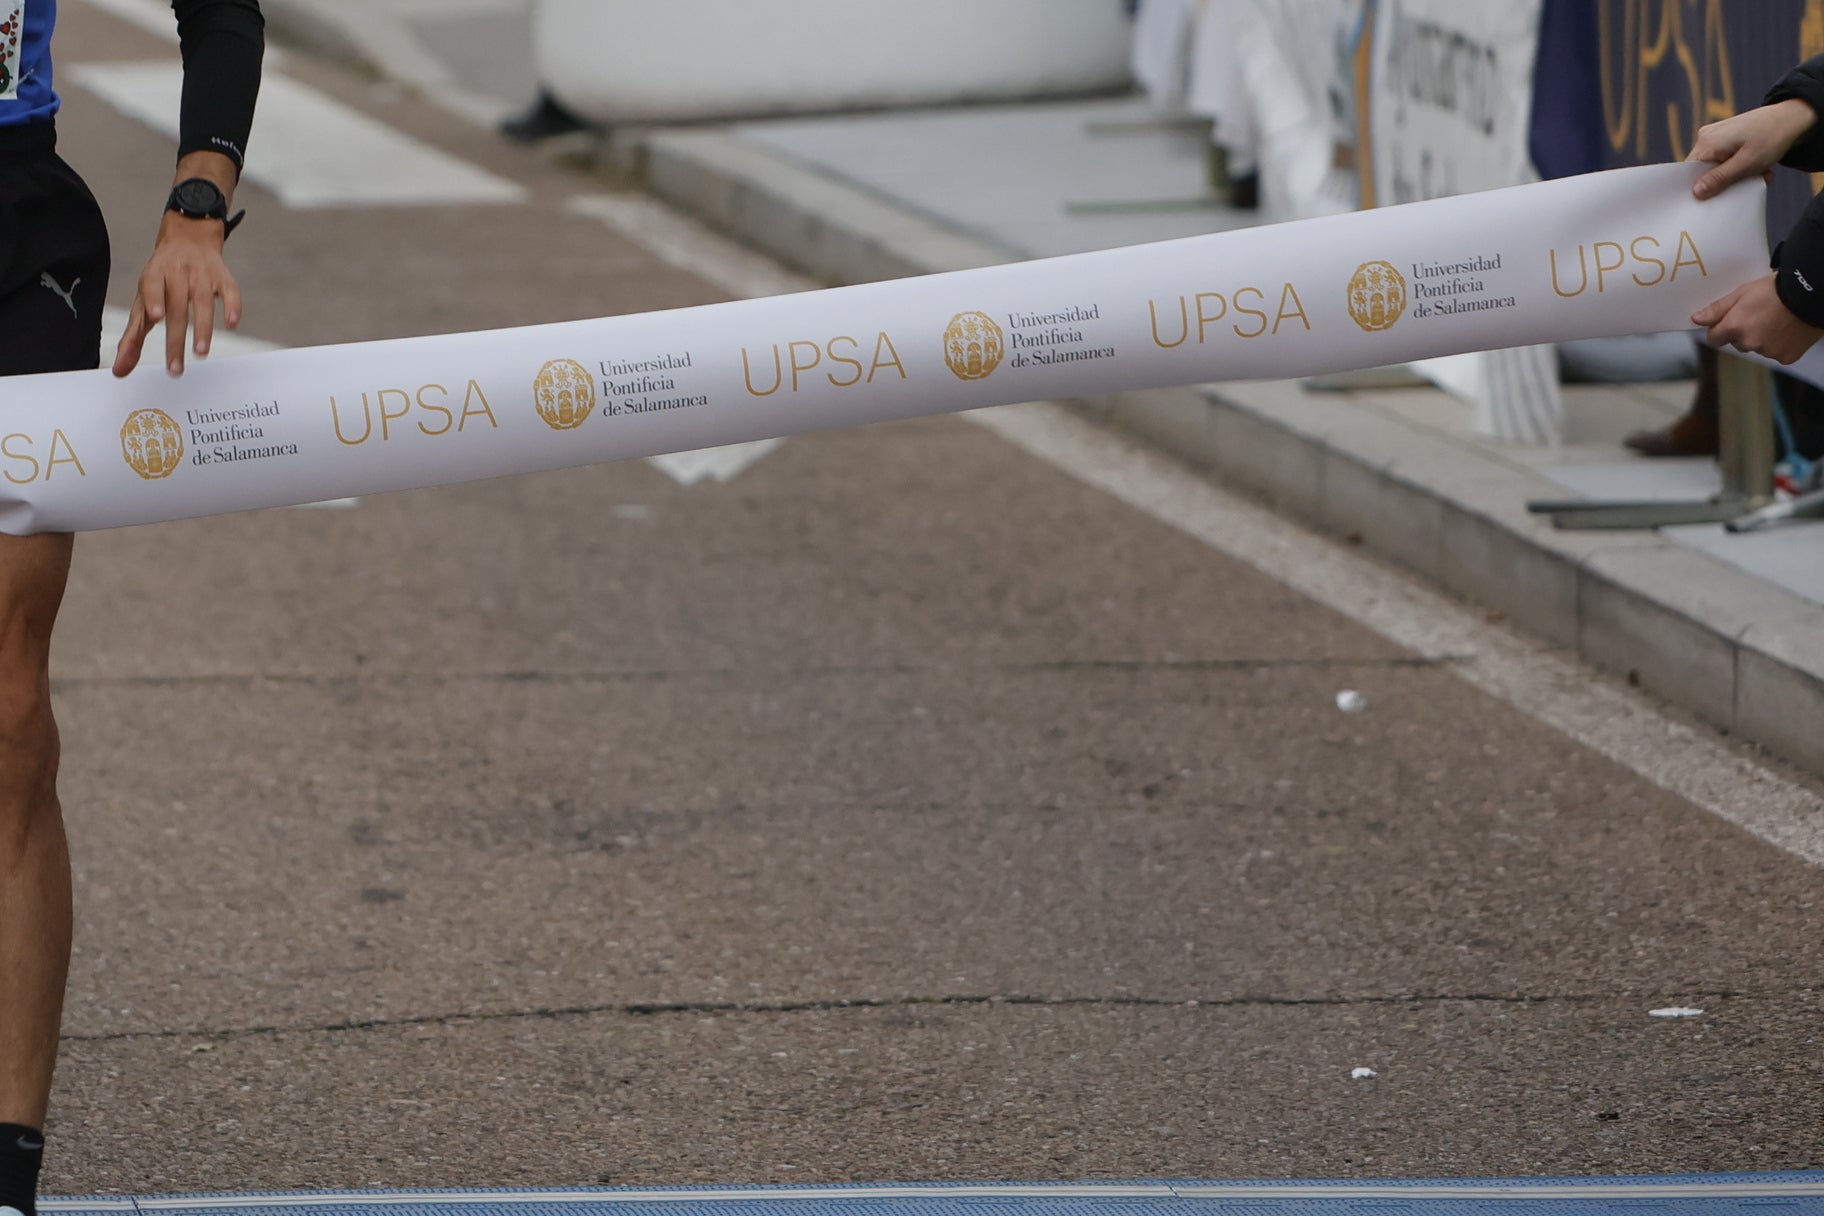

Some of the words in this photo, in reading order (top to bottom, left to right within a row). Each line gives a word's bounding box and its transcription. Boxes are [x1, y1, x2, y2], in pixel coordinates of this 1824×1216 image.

[1412, 253, 1501, 279] Universidad
[1550, 230, 1707, 298] UPSA
[1414, 277, 1484, 299] Pontificia
[1008, 304, 1100, 329] Universidad
[1148, 282, 1311, 350] UPSA
[1413, 303, 1432, 318] de
[1434, 296, 1516, 316] Salamanca
[1011, 327, 1083, 349] Pontificia
[599, 352, 692, 376] Universidad
[740, 331, 908, 397] UPSA
[1011, 353, 1030, 368] de
[1032, 347, 1115, 366] Salamanca
[602, 375, 675, 397] Pontificia
[186, 400, 280, 425] Universidad
[329, 379, 499, 446] UPSA
[603, 401, 622, 417] de
[624, 395, 708, 415] Salamanca
[190, 423, 264, 445] Pontificia
[192, 449, 211, 466] de
[213, 443, 298, 464] Salamanca
